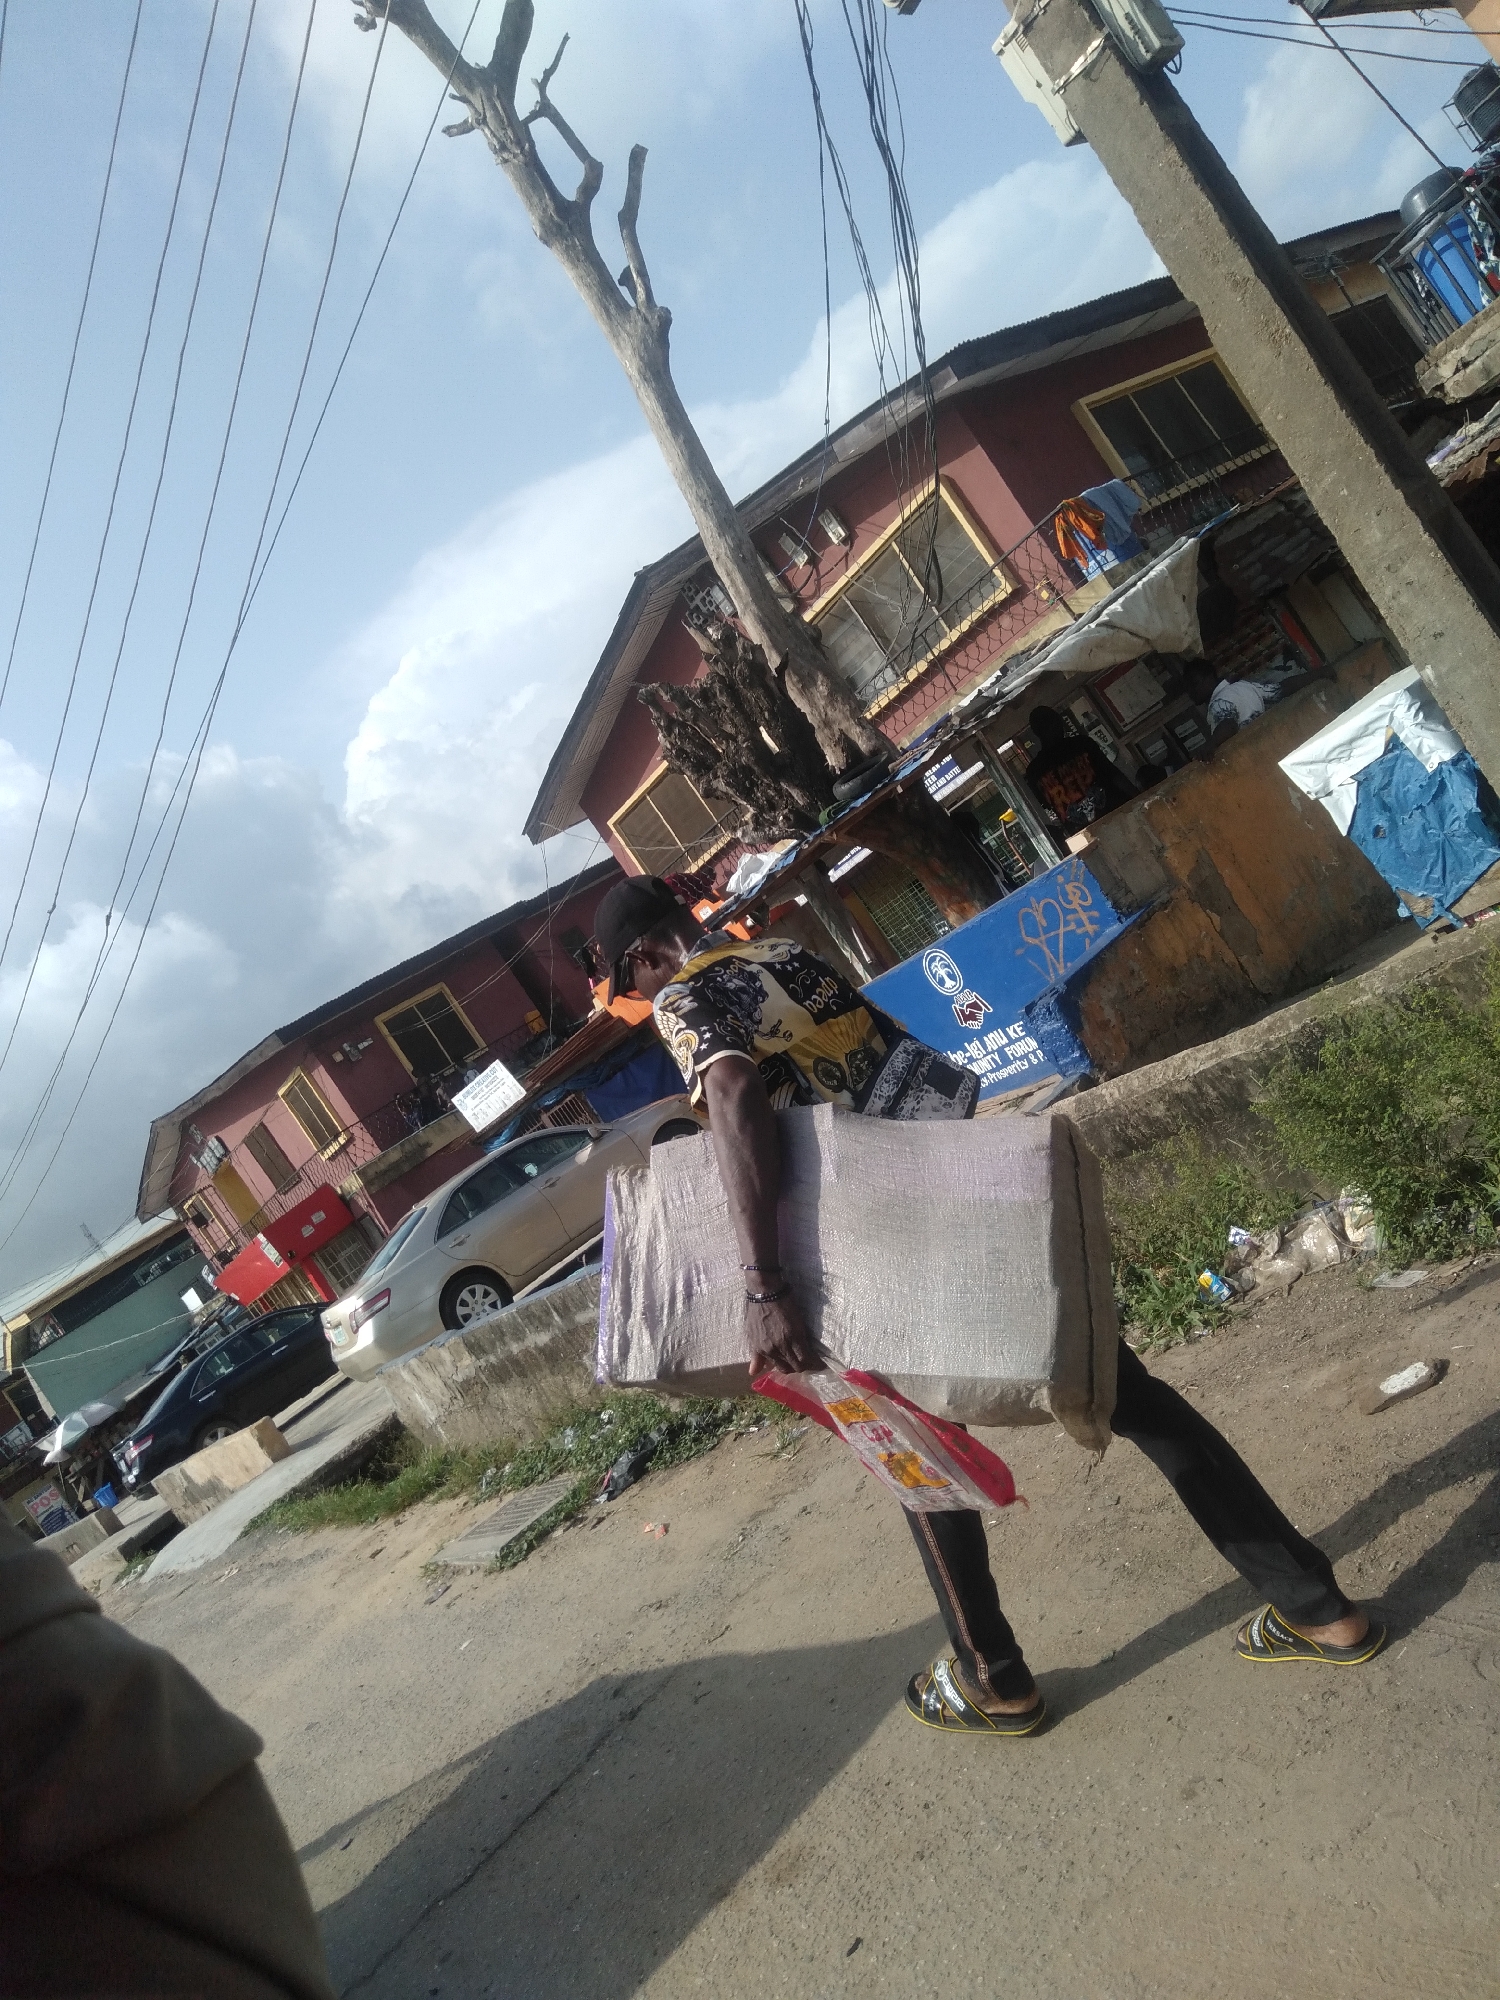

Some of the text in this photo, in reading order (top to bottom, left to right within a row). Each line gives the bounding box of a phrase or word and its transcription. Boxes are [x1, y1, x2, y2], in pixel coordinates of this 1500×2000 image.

[1028, 1053, 1038, 1065] &
[30, 1488, 59, 1514] POS
[1267, 1619, 1294, 1643] VERSACE
